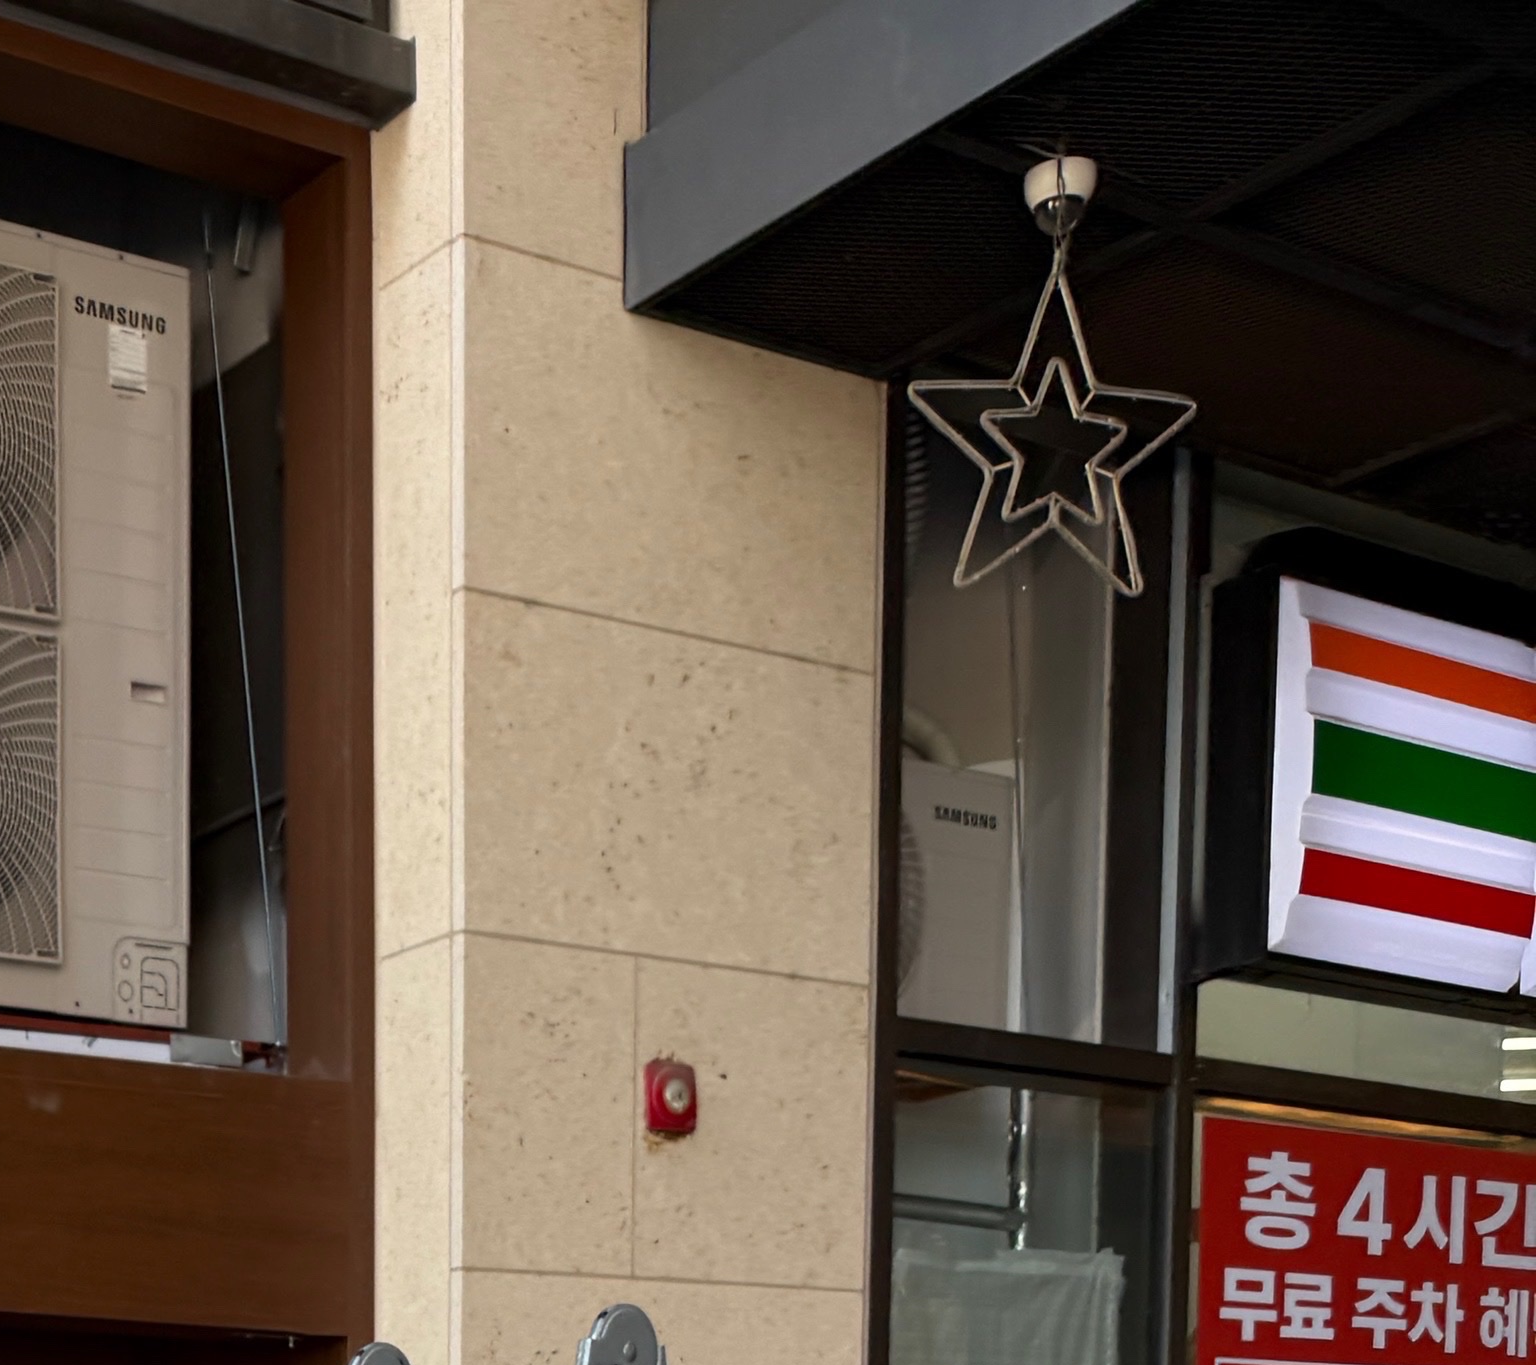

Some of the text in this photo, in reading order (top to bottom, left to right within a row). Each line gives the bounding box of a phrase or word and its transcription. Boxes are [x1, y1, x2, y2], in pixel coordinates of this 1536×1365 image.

[74, 295, 167, 335] SAMSUNG
[934, 805, 997, 830] SAMSUNG
[1240, 1151, 1317, 1251] 총
[1218, 1267, 1536, 1359] 무료 주차 혜
